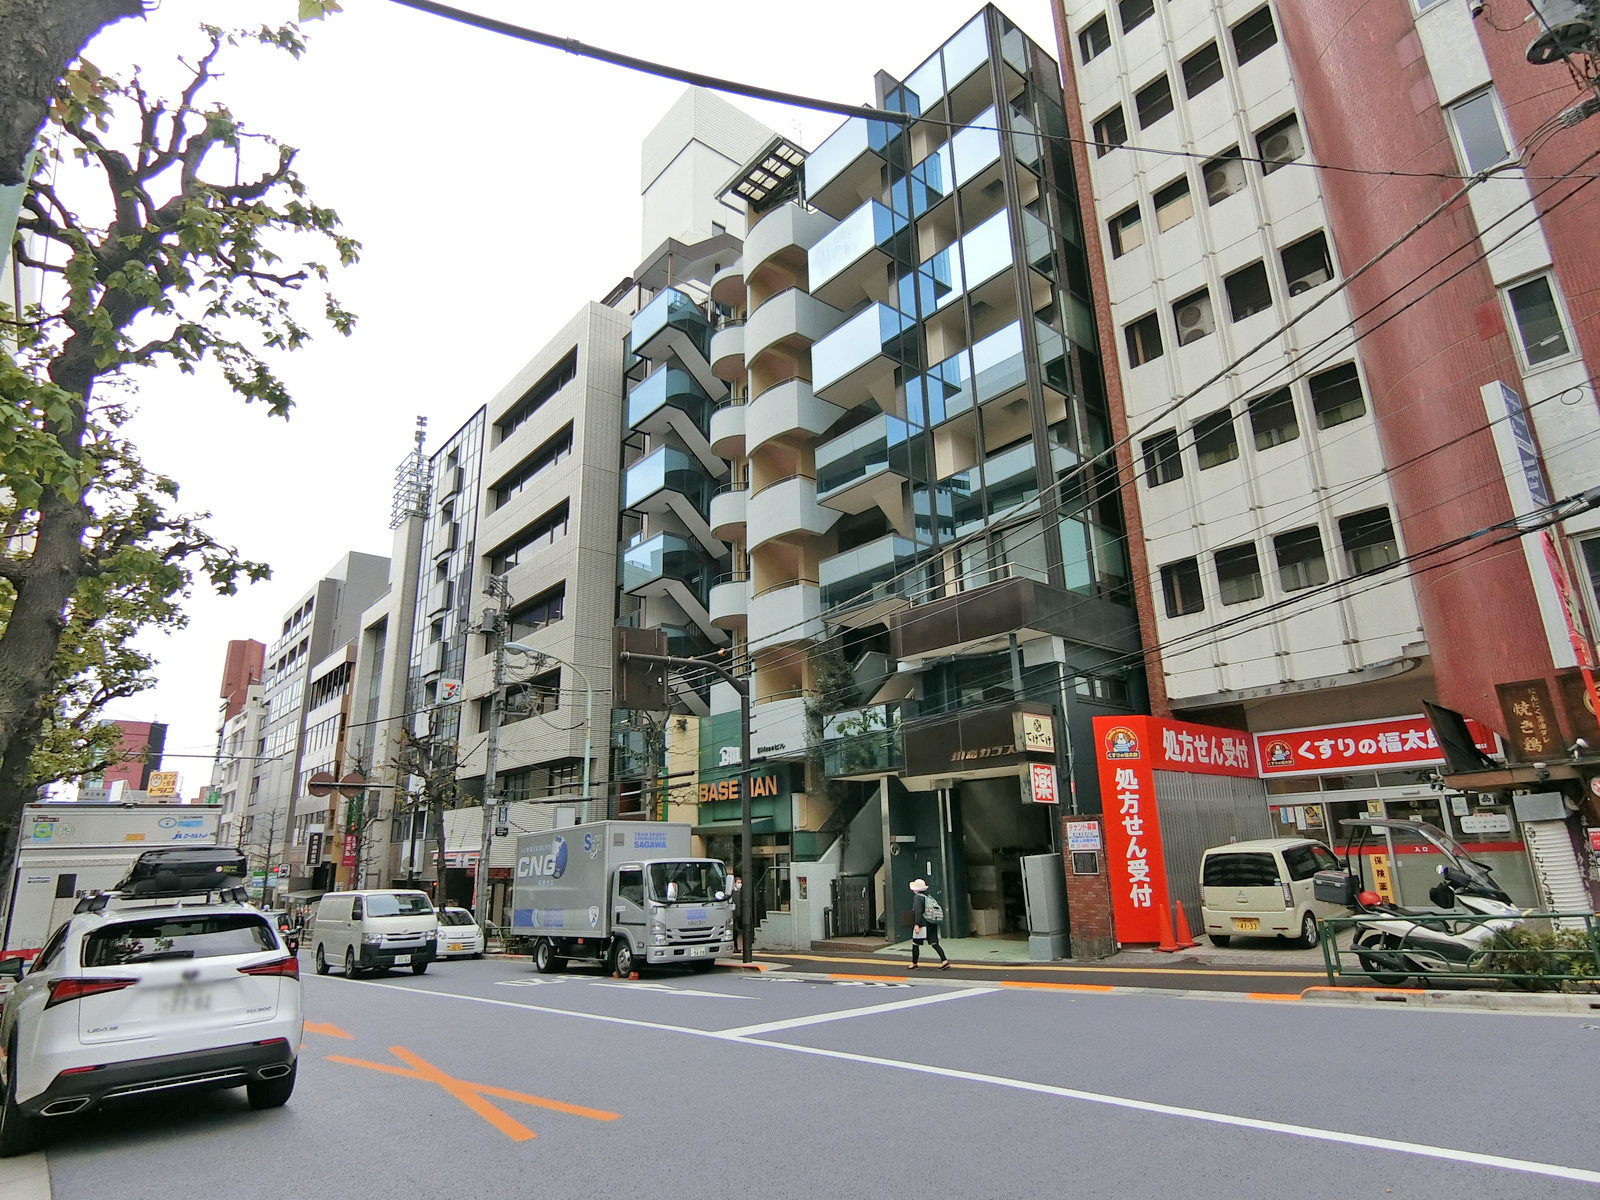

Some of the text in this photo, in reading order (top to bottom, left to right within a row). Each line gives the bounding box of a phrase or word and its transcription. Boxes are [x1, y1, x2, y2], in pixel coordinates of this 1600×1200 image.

[1026, 732, 1051, 746] てけてけ
[1162, 727, 1249, 769] 処方せん受付
[1034, 766, 1054, 800] 薬
[1069, 822, 1097, 832] テナント募集
[1114, 767, 1153, 908] 処方せん受付
[633, 840, 667, 849] SAGAWA
[517, 853, 557, 878] CNG
